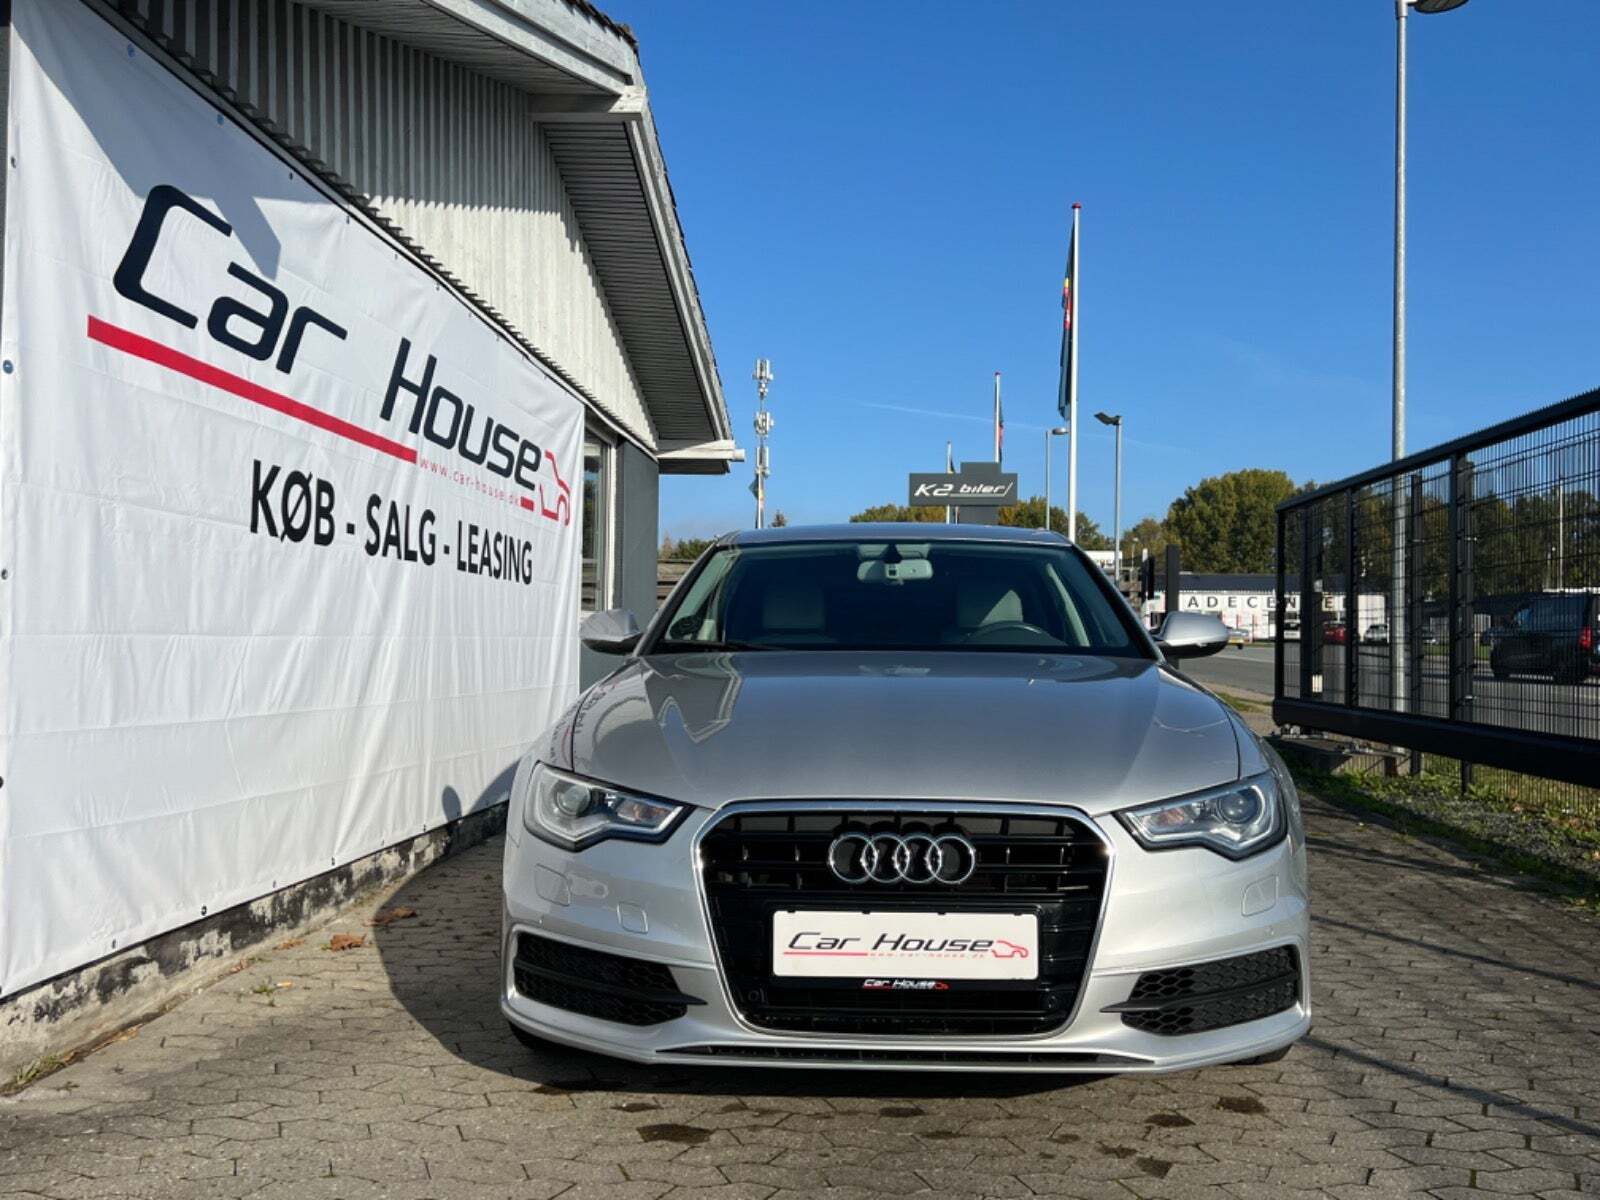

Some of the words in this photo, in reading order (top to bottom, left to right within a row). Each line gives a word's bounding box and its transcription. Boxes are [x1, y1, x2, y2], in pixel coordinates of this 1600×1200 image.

[113, 184, 348, 374] Car
[380, 337, 542, 491] House
[914, 483, 954, 497] K2
[250, 459, 335, 547] KØB
[364, 494, 436, 566] SALG
[457, 520, 532, 584] LEASING
[787, 931, 861, 950] Car
[871, 932, 994, 952] House
[863, 978, 889, 987] Car
[892, 978, 936, 989] House
